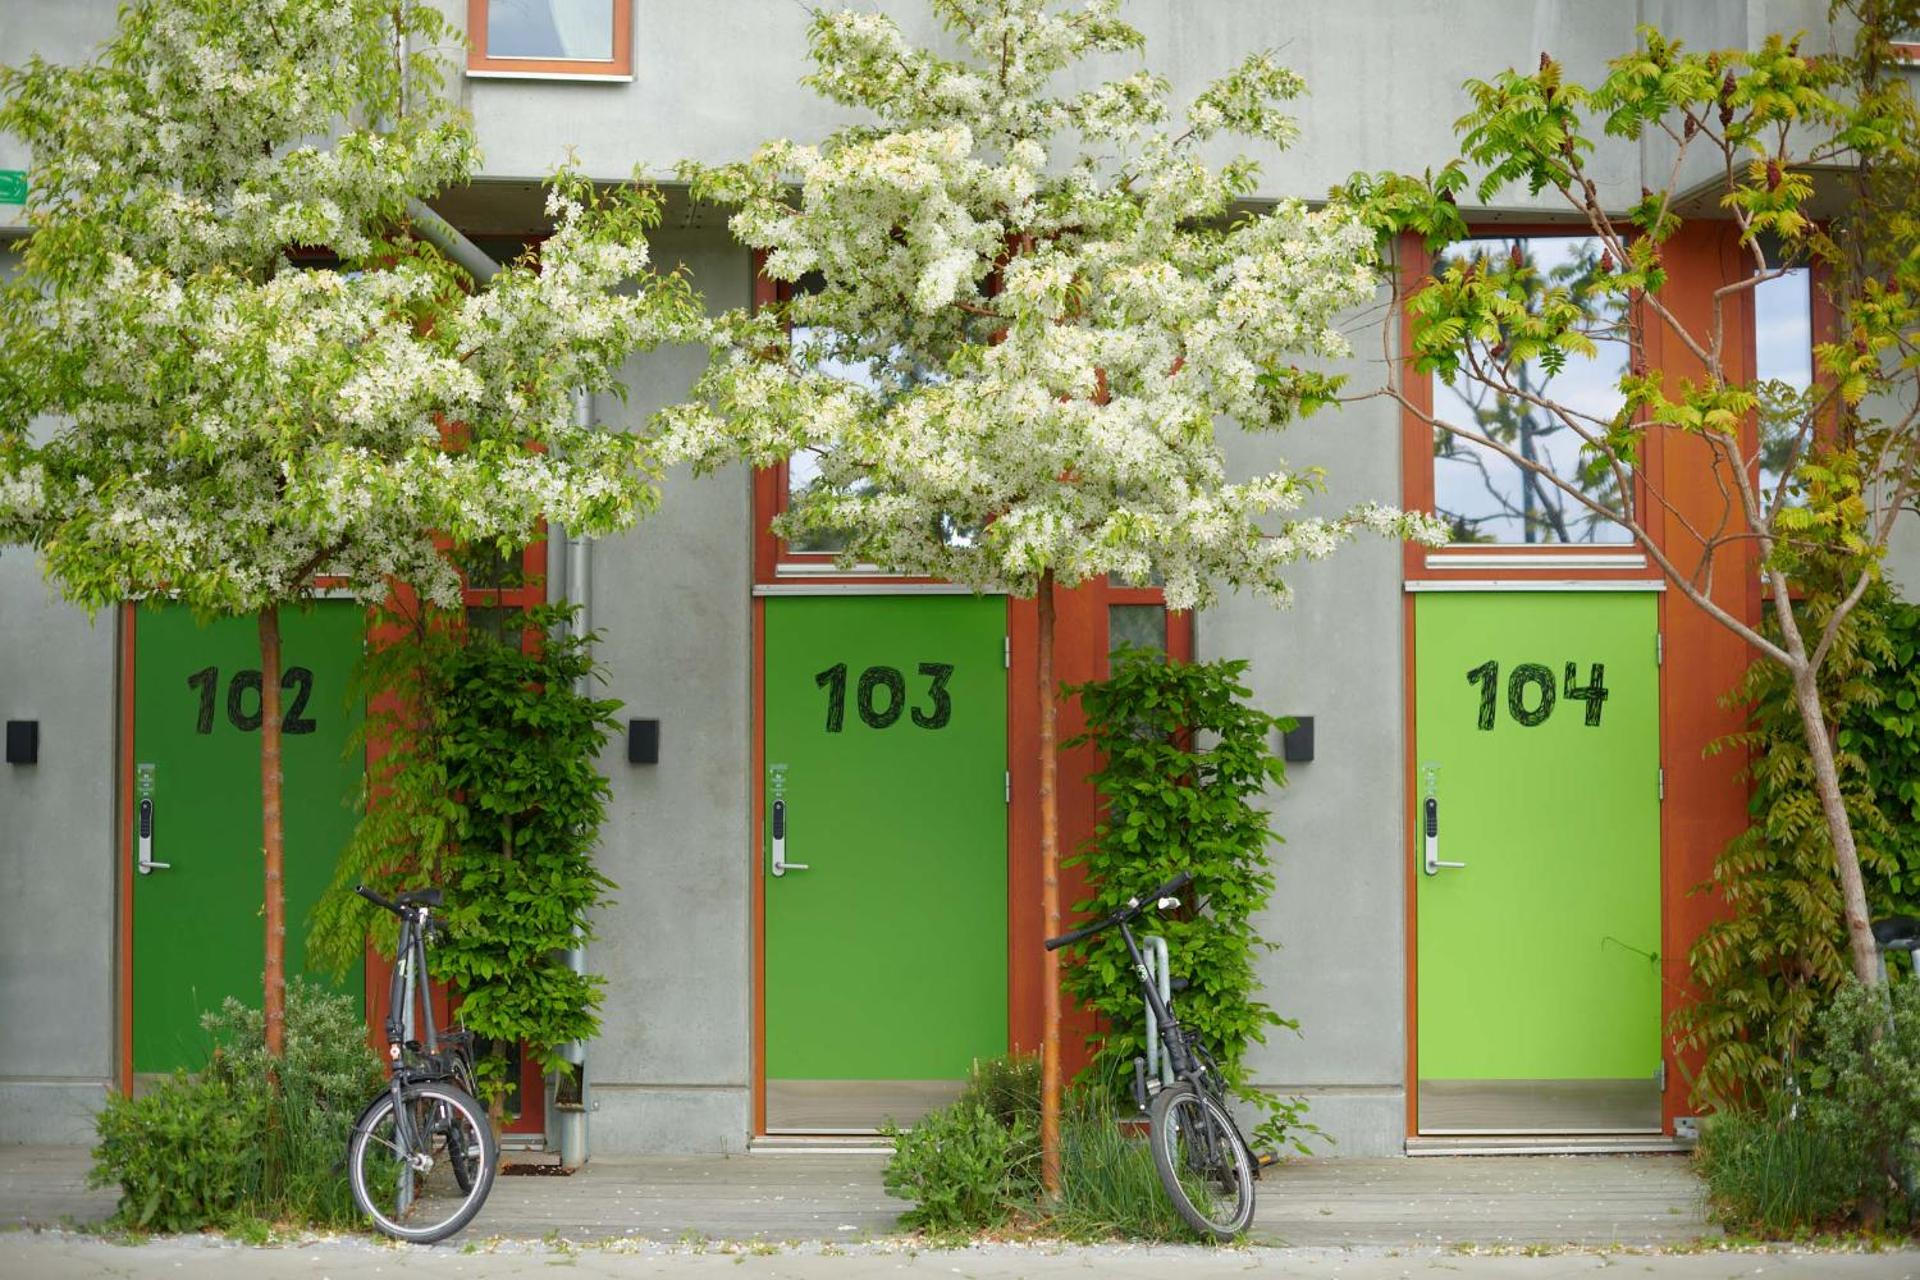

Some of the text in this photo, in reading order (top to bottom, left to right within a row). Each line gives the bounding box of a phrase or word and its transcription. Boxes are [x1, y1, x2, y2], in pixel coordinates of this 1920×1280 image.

[187, 666, 316, 734] 102
[815, 662, 954, 732] 103
[1466, 660, 1609, 731] 104
